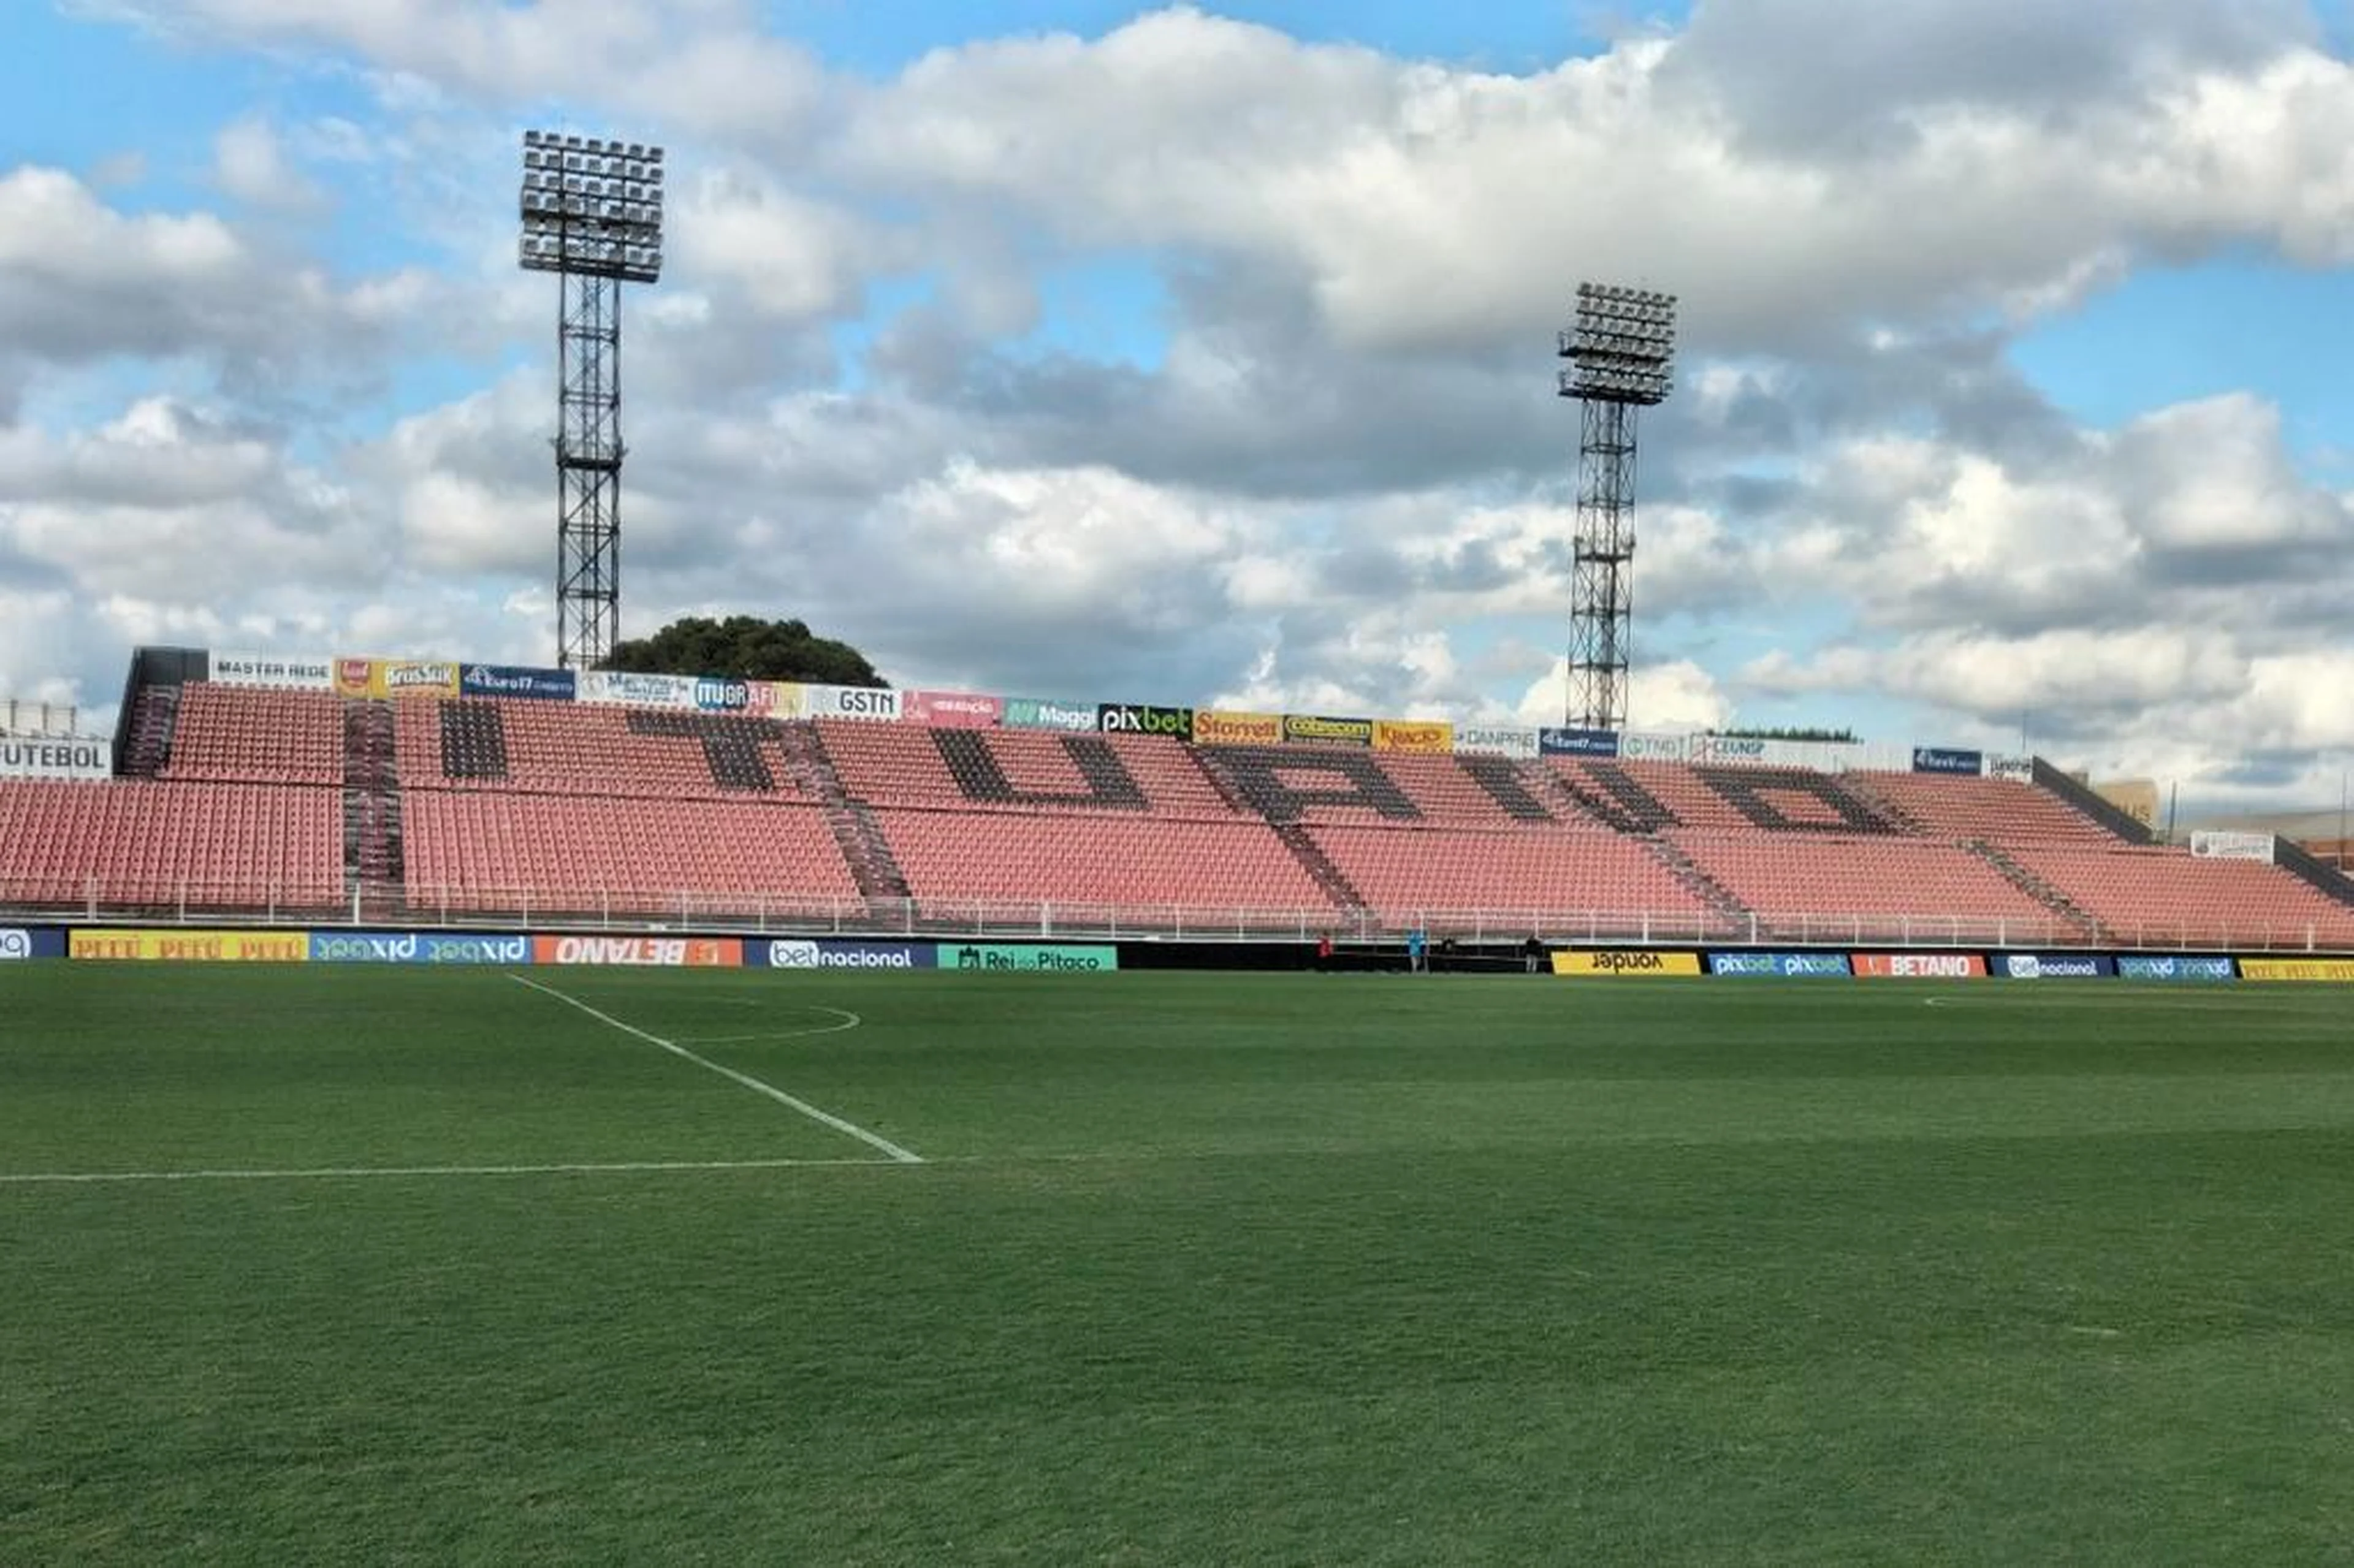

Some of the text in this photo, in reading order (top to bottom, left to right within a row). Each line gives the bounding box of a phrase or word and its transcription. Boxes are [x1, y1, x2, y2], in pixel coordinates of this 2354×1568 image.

[840, 690, 894, 714] GSTN
[1038, 706, 1097, 726] Maggi
[1103, 706, 1188, 733] pixbet
[0, 744, 105, 769] UTEBOL
[556, 938, 686, 964] BETANO
[986, 951, 1015, 969] Rei
[1038, 953, 1100, 970] Pitaco
[1591, 953, 1663, 973] vonder
[1891, 956, 1970, 976] BETANO
